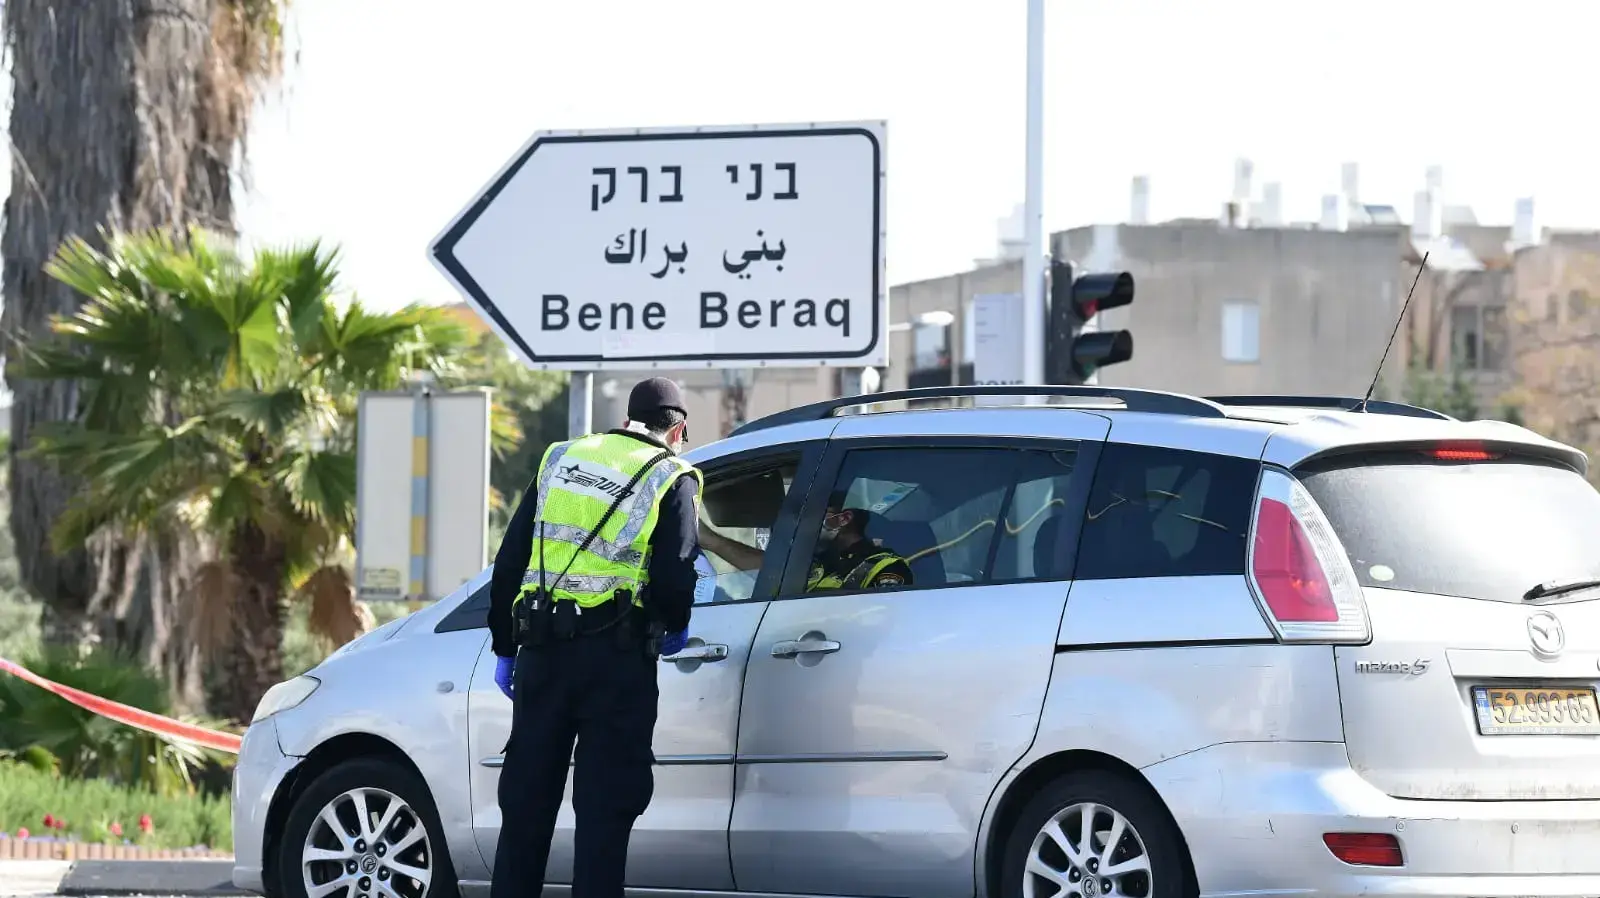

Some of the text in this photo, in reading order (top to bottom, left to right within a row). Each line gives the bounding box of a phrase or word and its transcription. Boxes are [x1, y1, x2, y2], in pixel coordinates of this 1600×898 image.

[592, 163, 798, 211] בני ברק
[605, 229, 785, 279] بني براك
[542, 292, 849, 336] Bene Beraq
